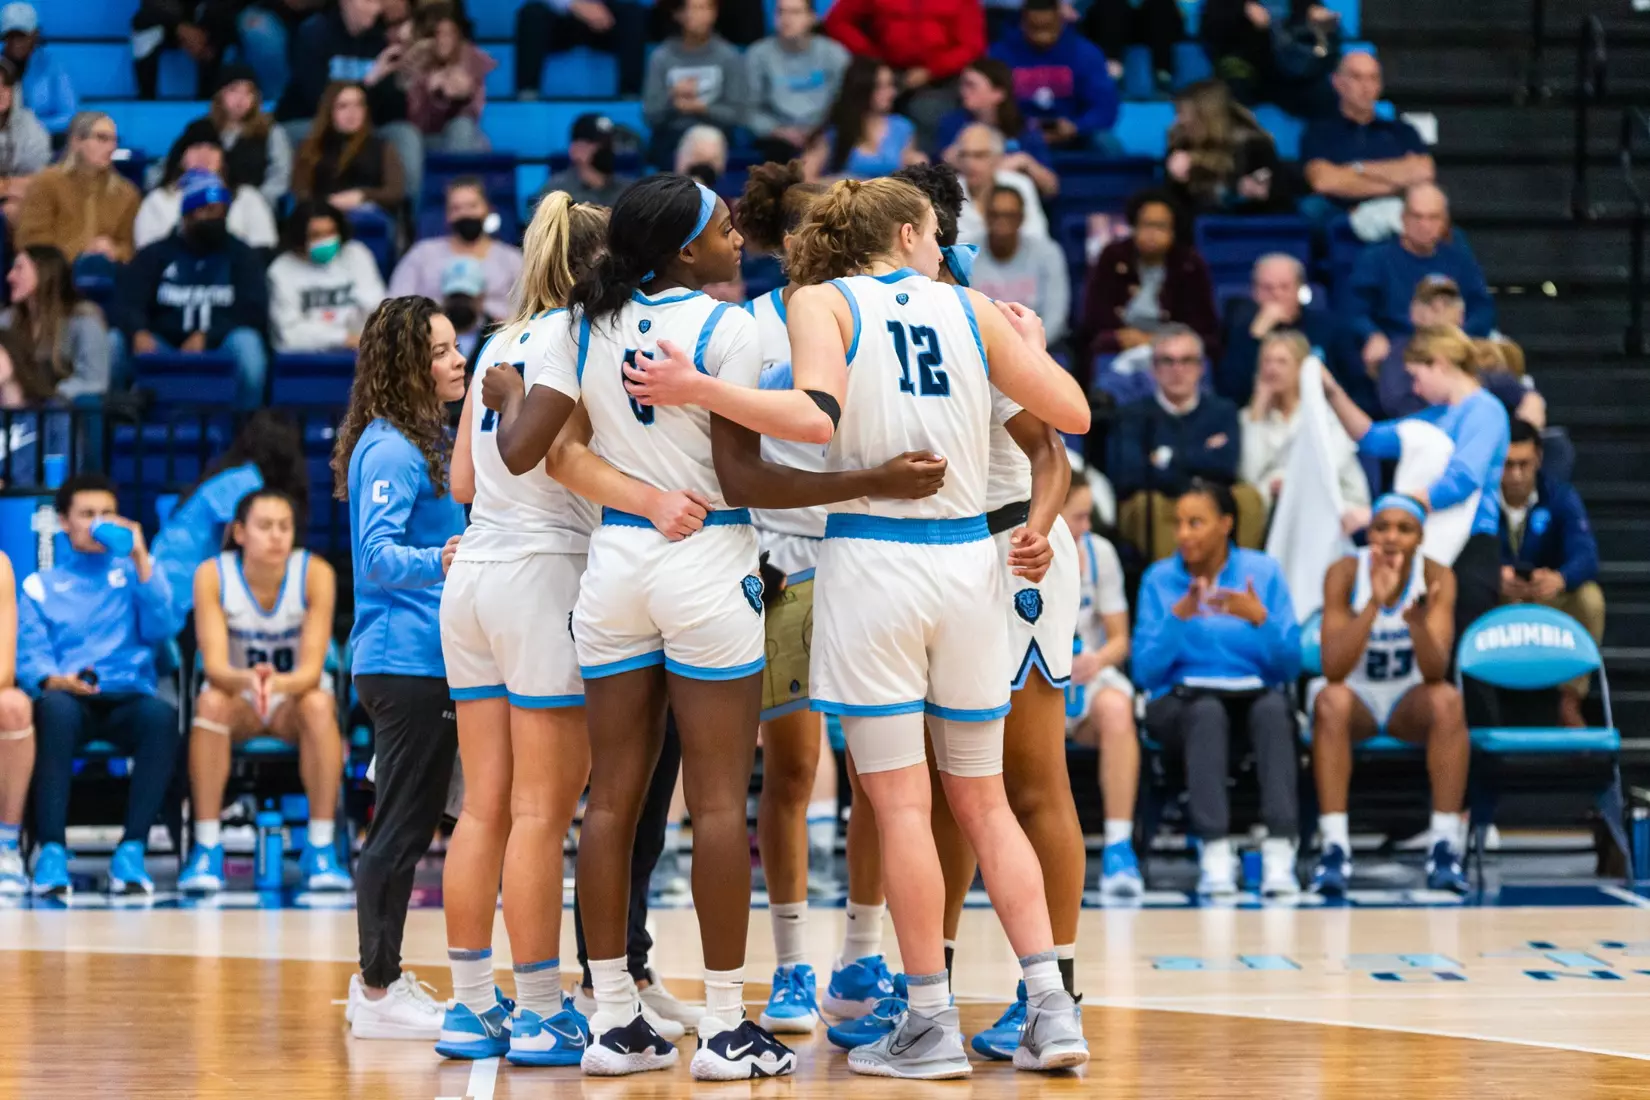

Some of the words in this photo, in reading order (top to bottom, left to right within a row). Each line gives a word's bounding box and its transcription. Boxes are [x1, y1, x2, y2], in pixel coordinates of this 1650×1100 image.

[886, 319, 951, 397] 12
[372, 479, 390, 504] C
[1475, 622, 1576, 651] COLUMBIA
[1366, 648, 1413, 680] 23
